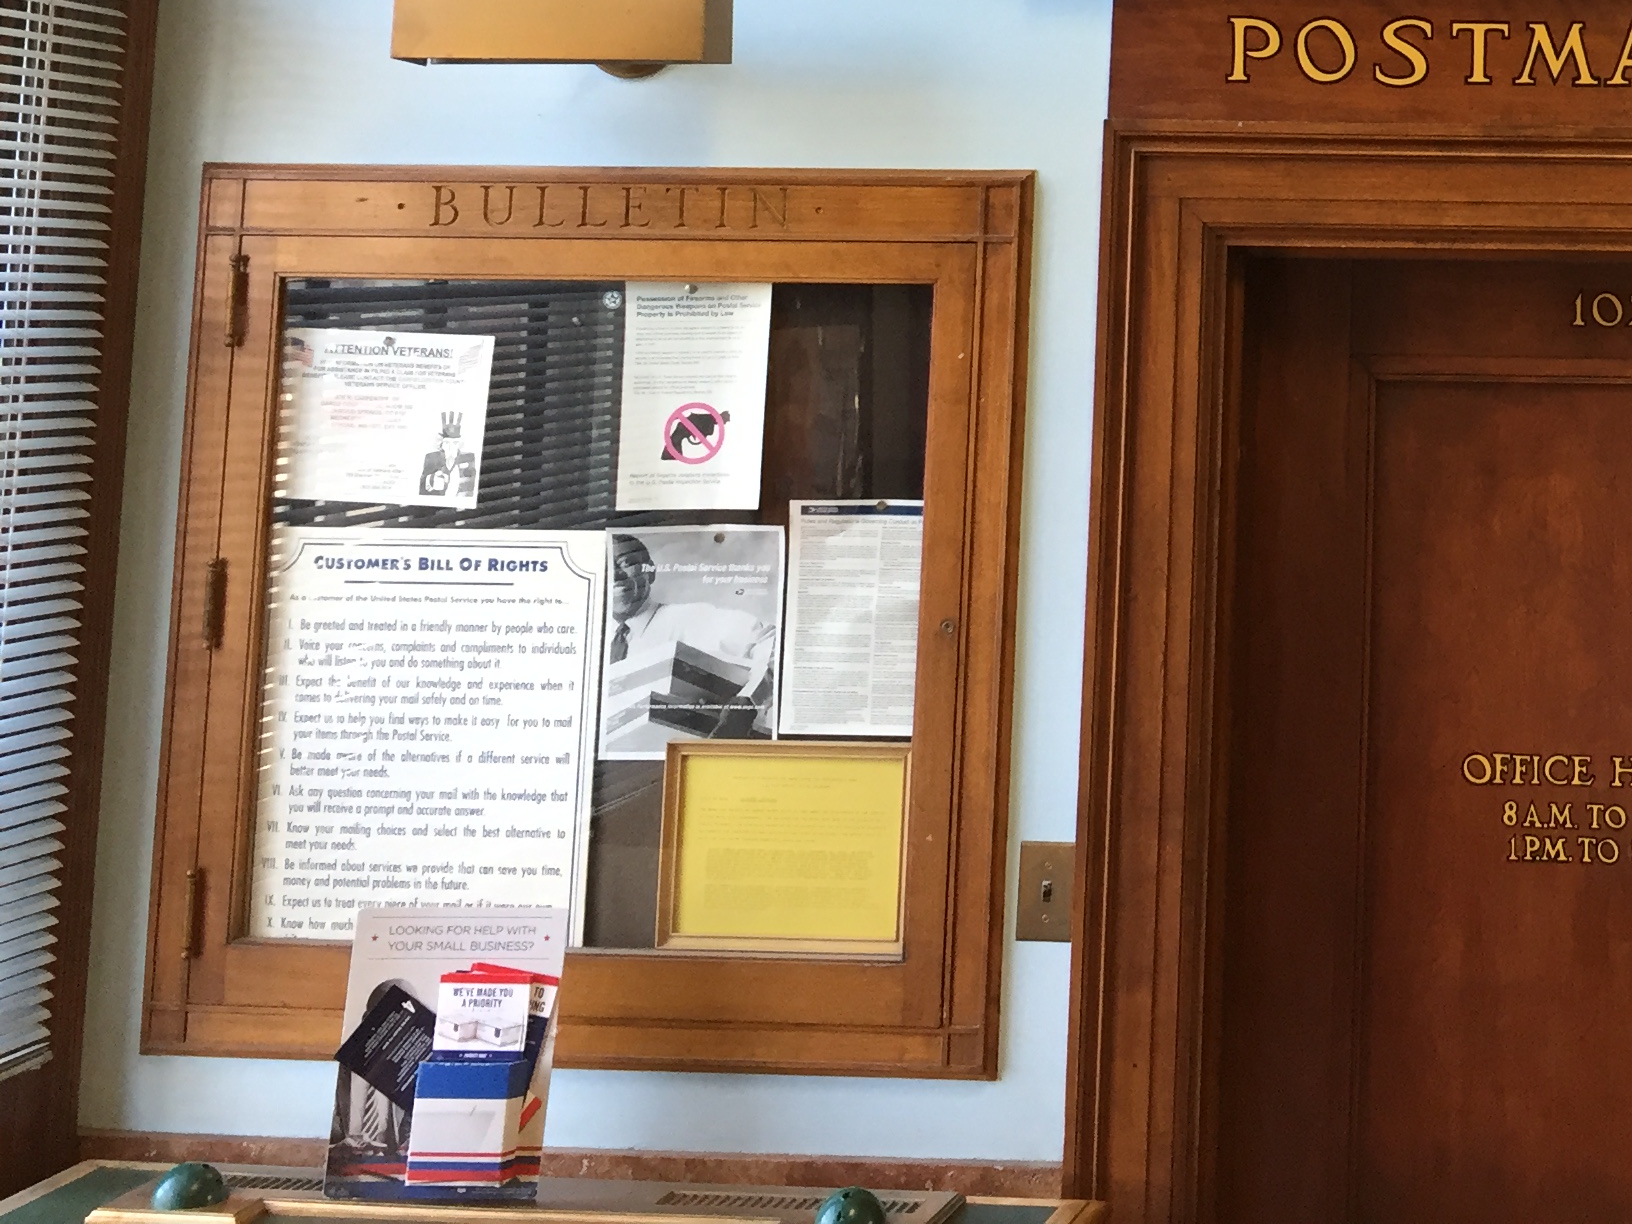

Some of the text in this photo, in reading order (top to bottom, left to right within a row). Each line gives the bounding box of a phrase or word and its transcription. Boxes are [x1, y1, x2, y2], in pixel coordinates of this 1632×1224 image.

[429, 184, 794, 231] BULLETIN
[418, 557, 453, 571] BILL
[459, 557, 482, 571] OF
[487, 557, 549, 572] RIGHTS
[300, 619, 311, 631] Be
[313, 619, 346, 633] greeted
[348, 619, 365, 631] and
[367, 619, 398, 631] treated
[400, 620, 409, 631] in
[419, 620, 452, 635] friendly
[455, 623, 489, 633] manner
[491, 621, 502, 635] by
[505, 621, 533, 636] people
[537, 621, 553, 634] who
[1463, 753, 1595, 785] OFFICE
[1586, 804, 1626, 829] TO
[1577, 837, 1619, 863] TO
[388, 925, 536, 936] LOOKING FOR HELP WITH
[388, 941, 535, 952] YOUR SMALL BUSINESS?
